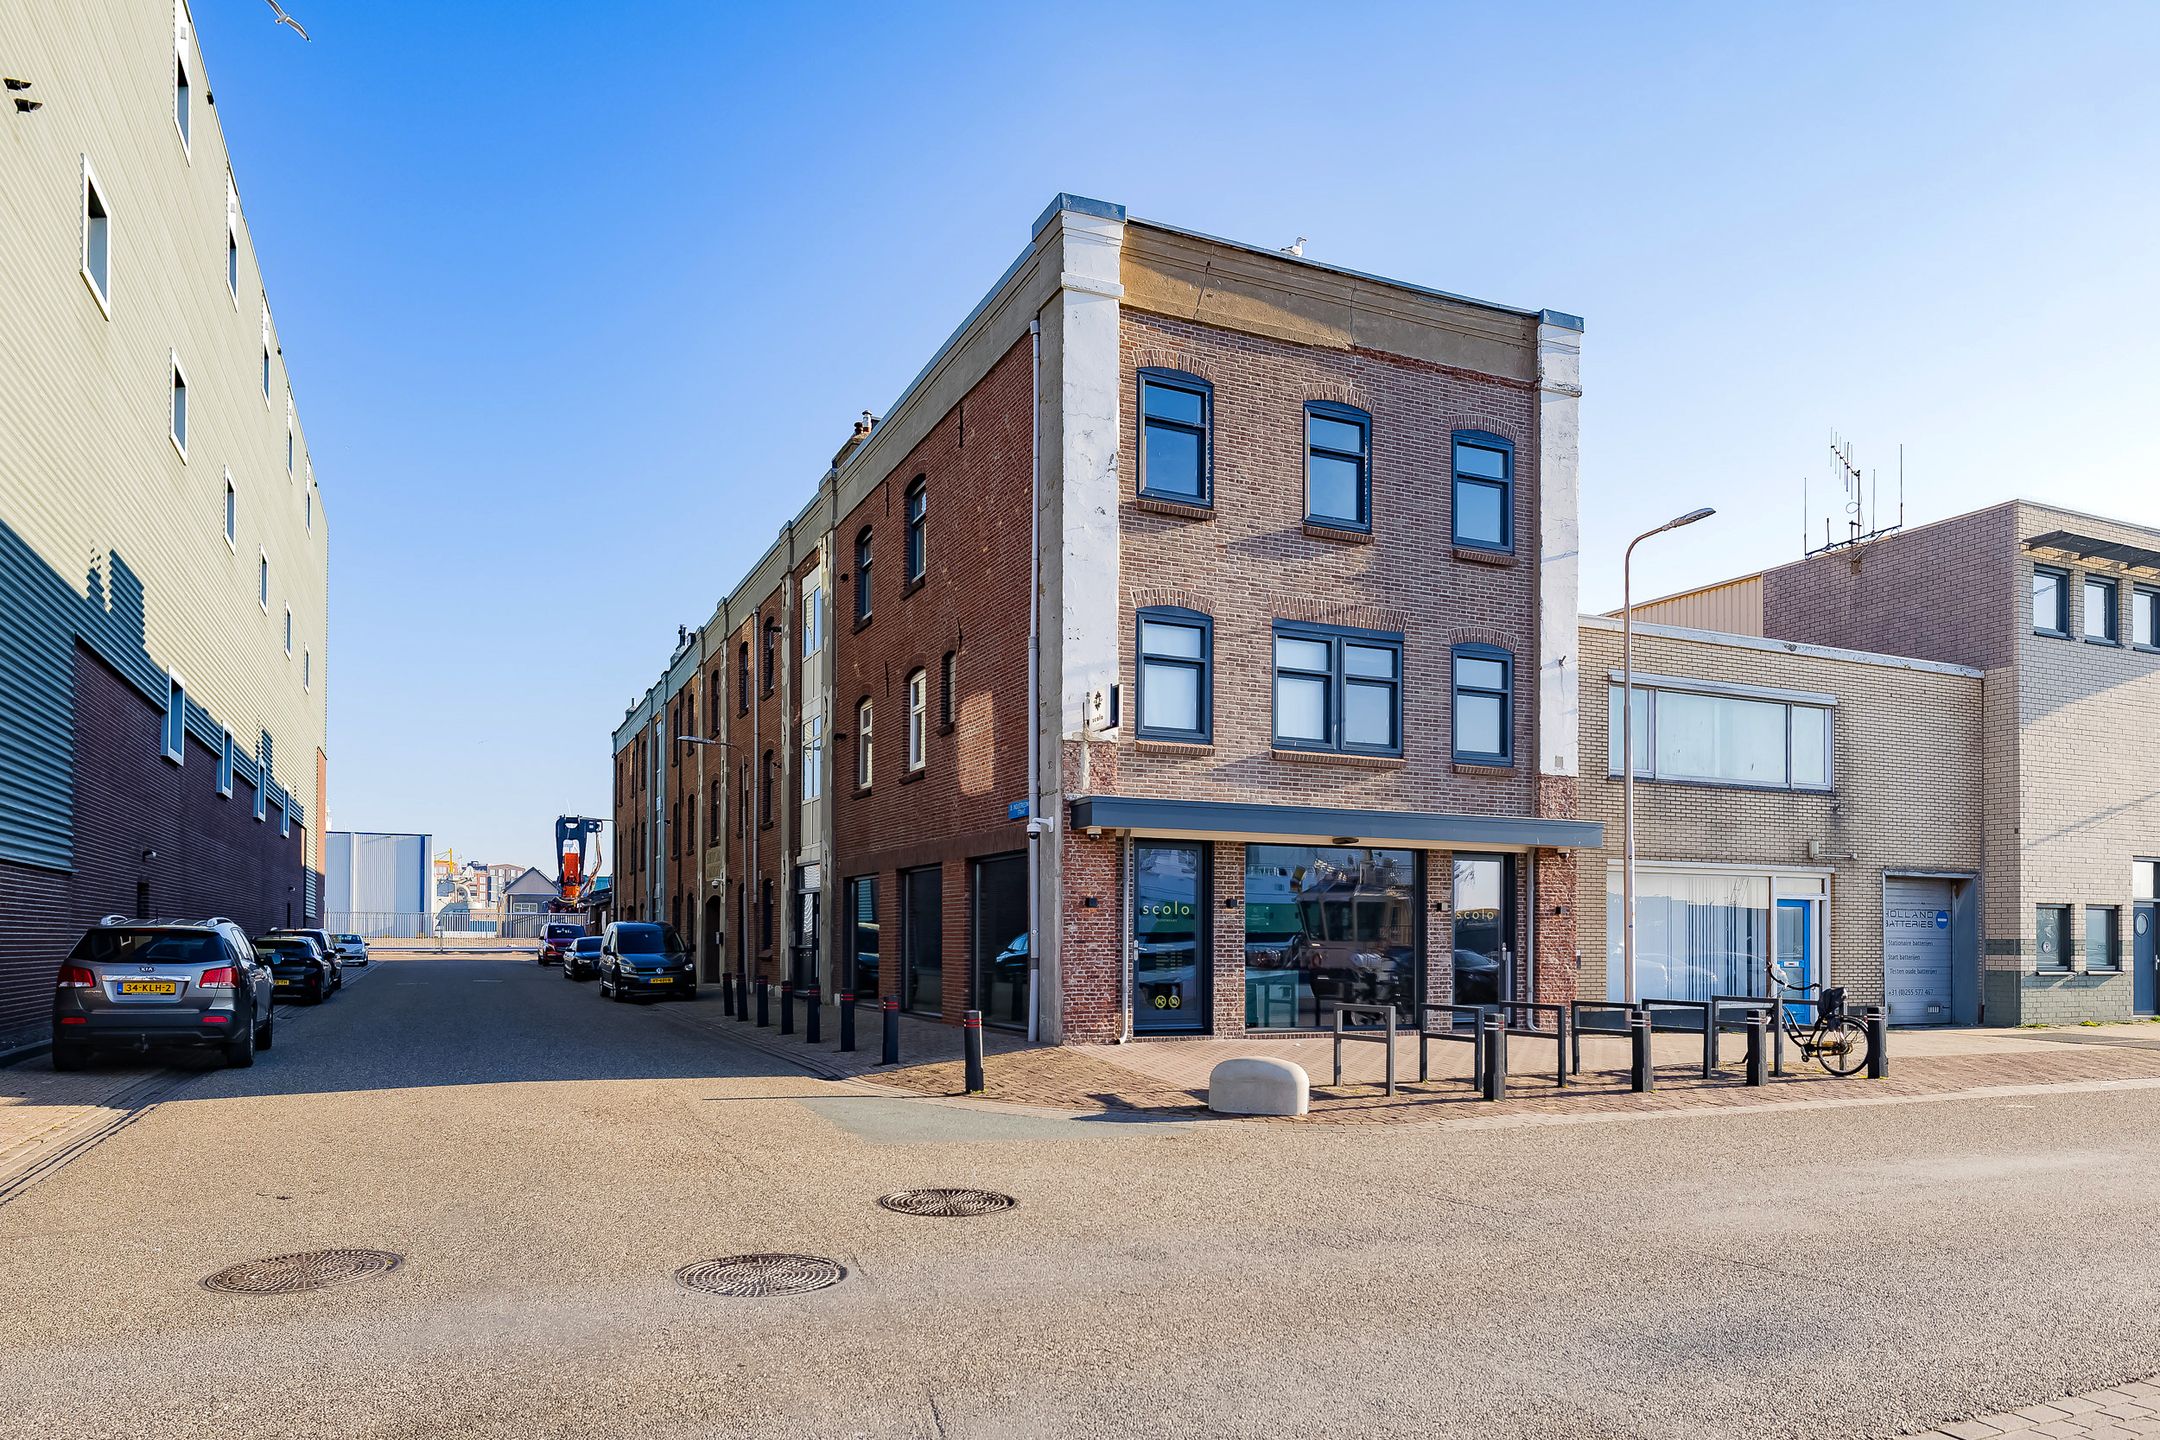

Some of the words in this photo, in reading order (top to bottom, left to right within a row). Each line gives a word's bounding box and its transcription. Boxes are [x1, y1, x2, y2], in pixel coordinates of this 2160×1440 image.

[1142, 900, 1190, 915] scolo
[1456, 909, 1494, 920] scolo
[126, 984, 171, 992] 34-KLH-2
